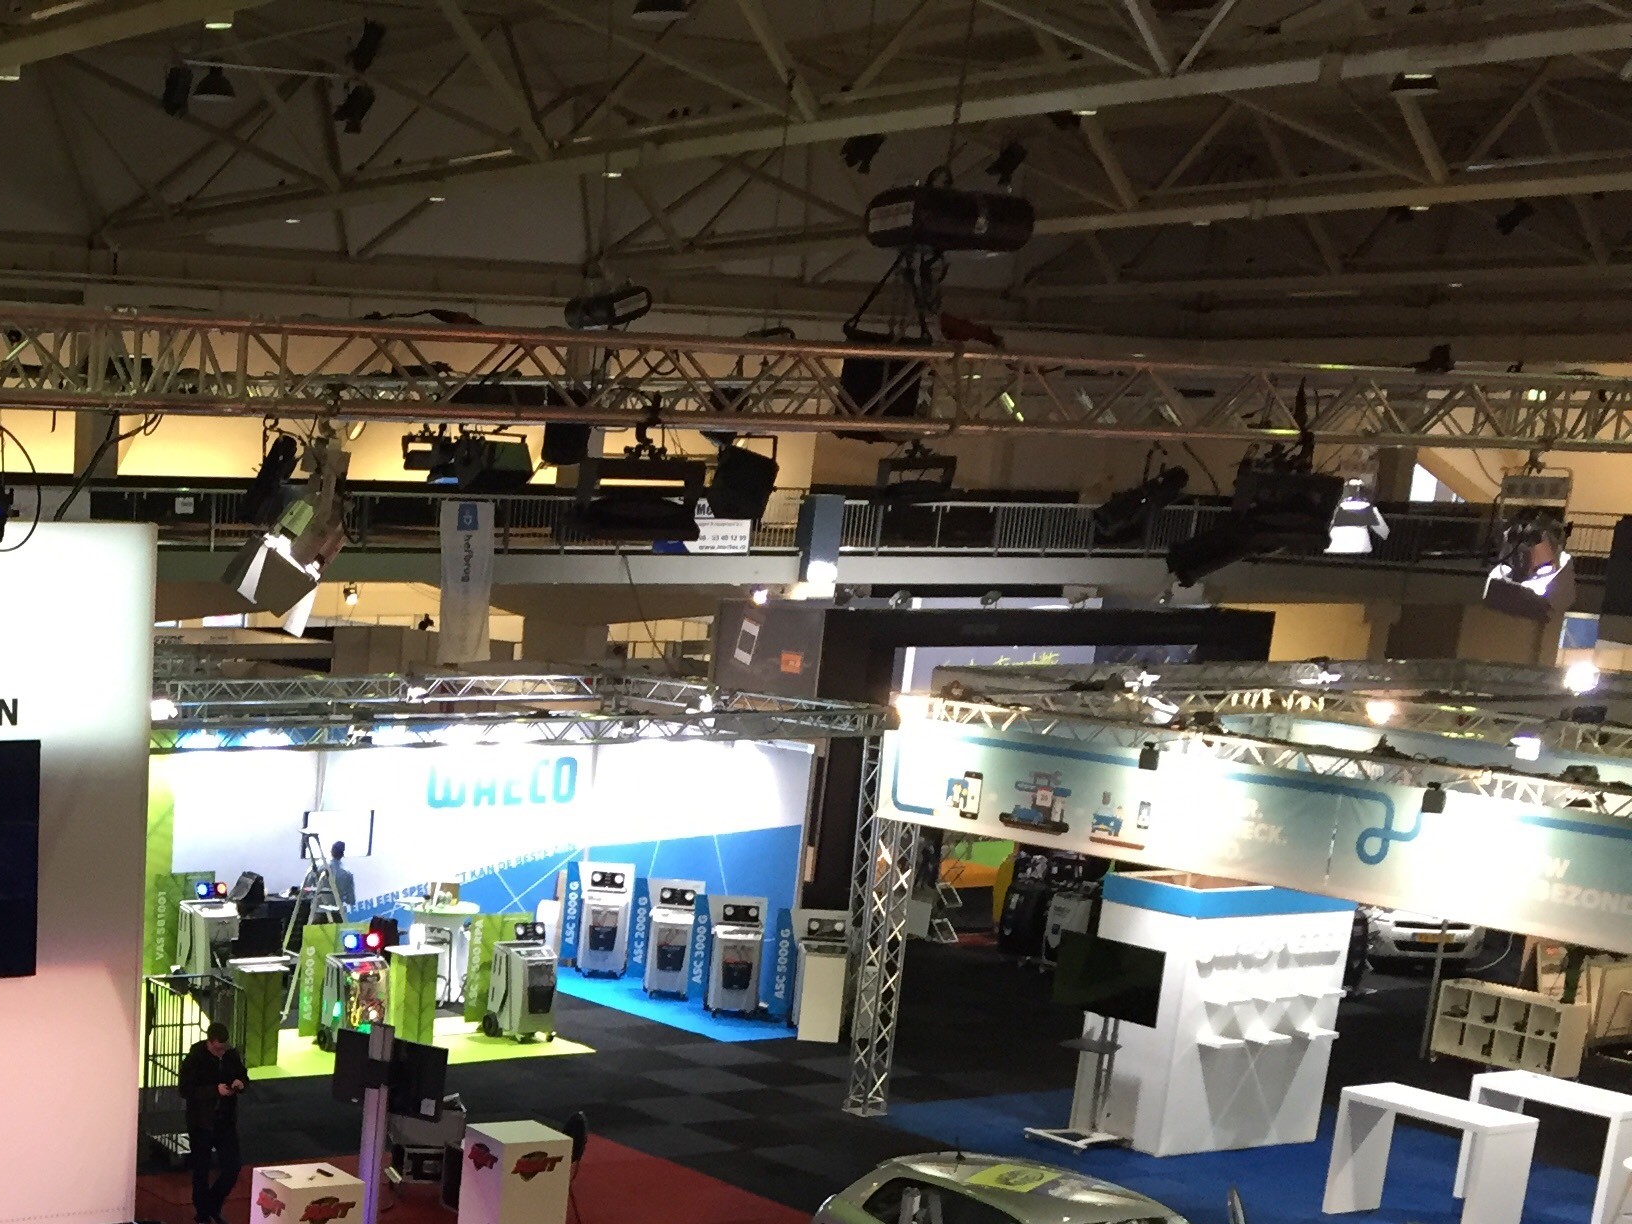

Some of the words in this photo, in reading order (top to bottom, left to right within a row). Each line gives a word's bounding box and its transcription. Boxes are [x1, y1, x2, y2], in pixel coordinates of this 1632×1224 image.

[569, 881, 580, 891] G
[638, 896, 648, 906] G
[634, 907, 647, 939] 2000
[697, 914, 708, 925] G
[564, 922, 576, 945] ASC
[694, 925, 707, 959] 3000
[780, 928, 791, 938] G
[306, 945, 316, 957] G
[632, 940, 645, 964] ASC
[776, 939, 790, 973] 5000
[691, 960, 705, 985] ASC
[774, 974, 787, 1000] ASC
